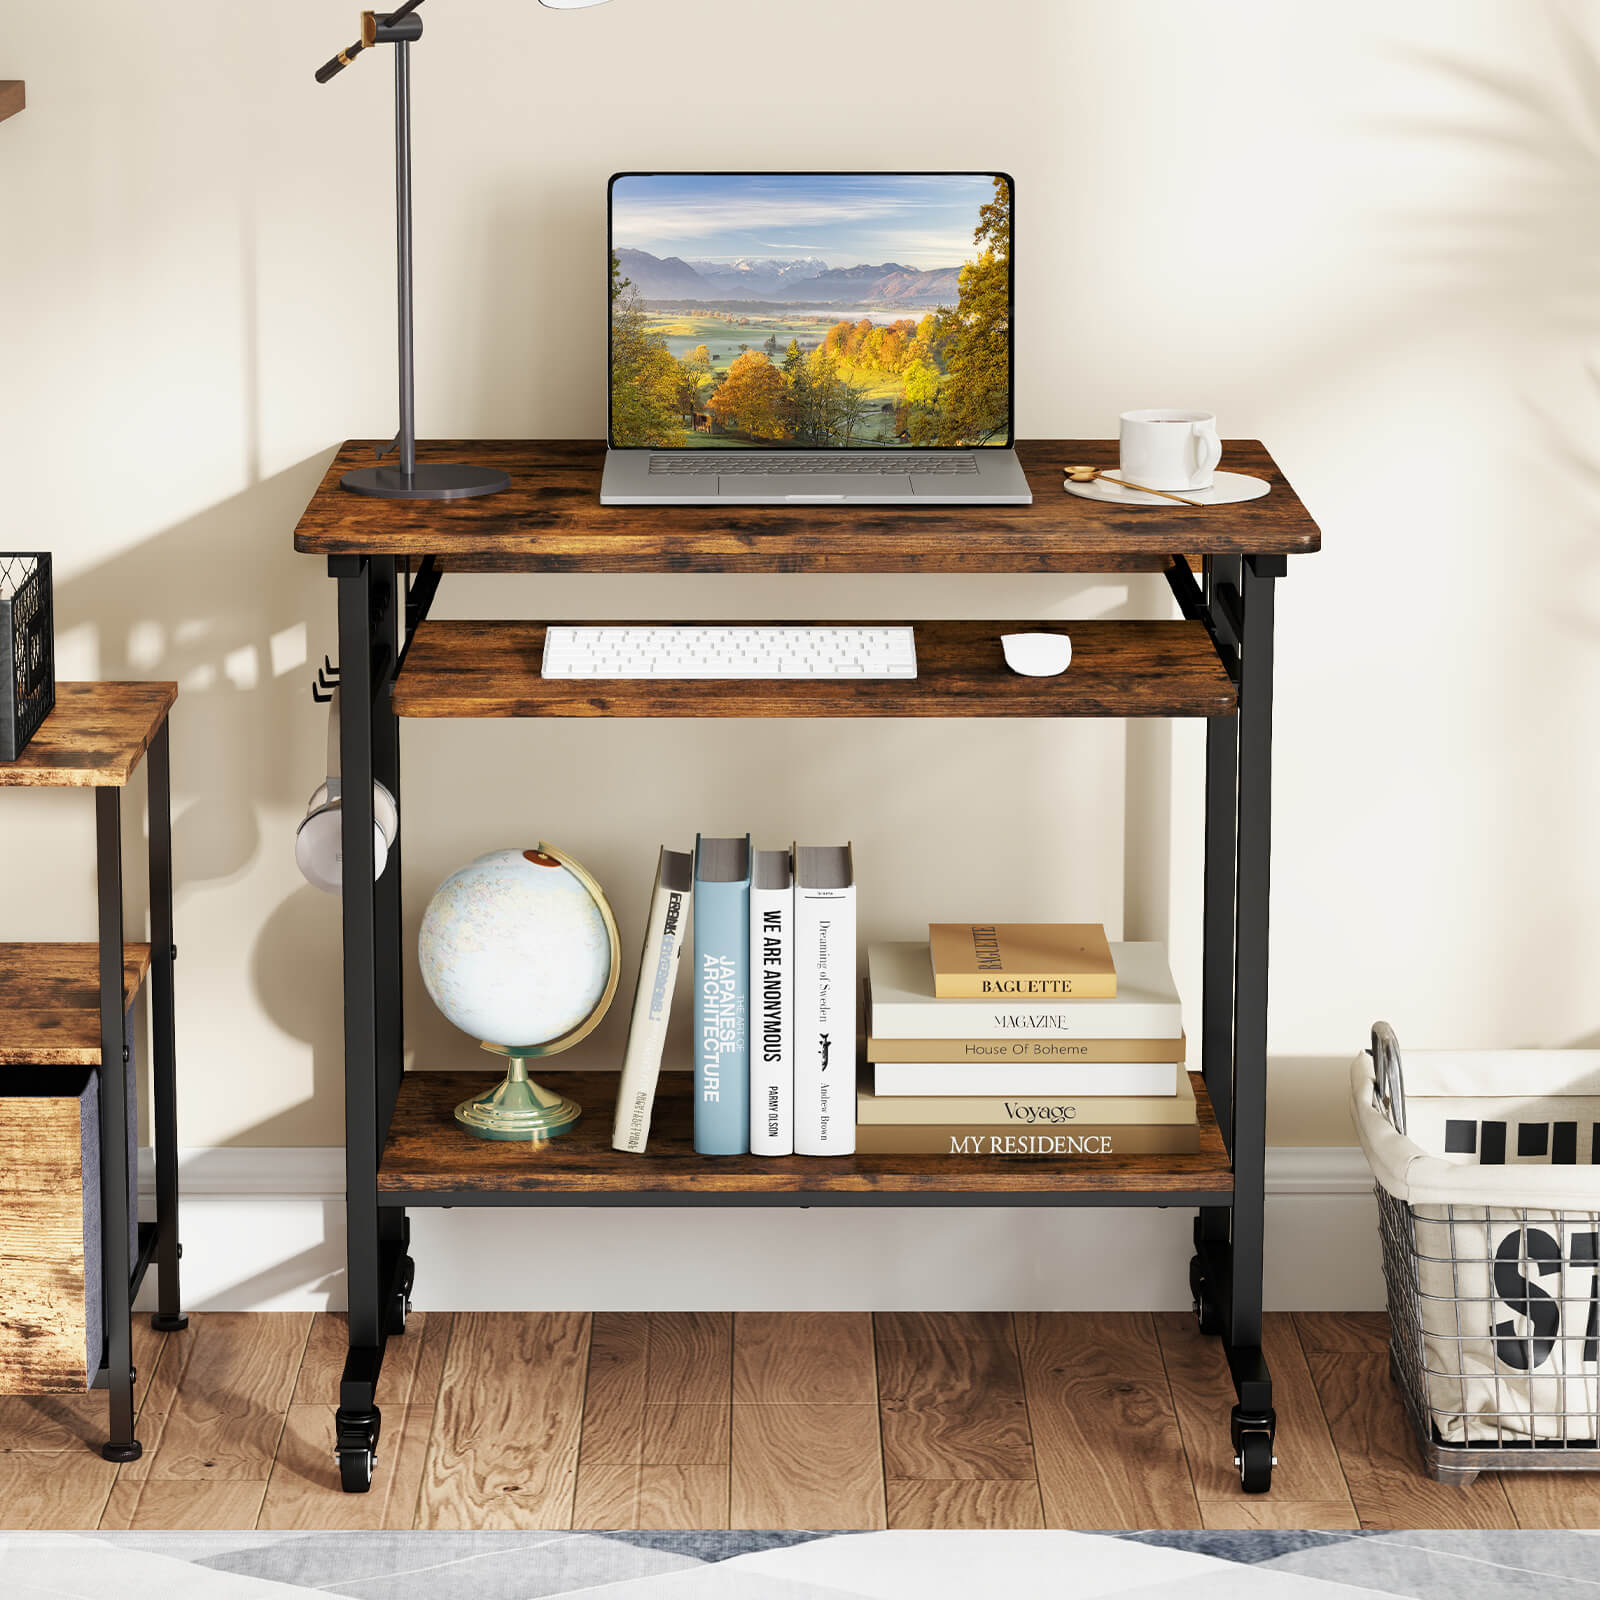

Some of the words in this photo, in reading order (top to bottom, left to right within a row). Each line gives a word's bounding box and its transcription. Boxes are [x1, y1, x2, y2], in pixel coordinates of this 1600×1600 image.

[763, 910, 782, 933] WE
[763, 937, 782, 966] ARE
[816, 920, 832, 969] Dreaming
[819, 971, 832, 983] of
[982, 980, 1072, 993] BAGUETTE
[719, 955, 736, 1053] JAPANESE
[735, 994, 745, 1014] THE
[819, 984, 832, 1023] Sweden
[735, 1016, 745, 1035] ART
[763, 969, 782, 1063] ANONYMOUS
[994, 1015, 1070, 1030] MAGAZINE
[703, 954, 720, 1103] ARCHITECTURE
[965, 1043, 1008, 1055] House
[1012, 1043, 1030, 1055] Of
[1033, 1043, 1088, 1055] Boheme
[768, 1086, 779, 1112] PARMY
[819, 1082, 831, 1114] Andrew
[1004, 1101, 1077, 1123] Voyage
[768, 1113, 779, 1137] OLSON
[819, 1115, 831, 1141] Brown
[949, 1135, 986, 1154] MY
[989, 1135, 1113, 1154] RESIDENCE
